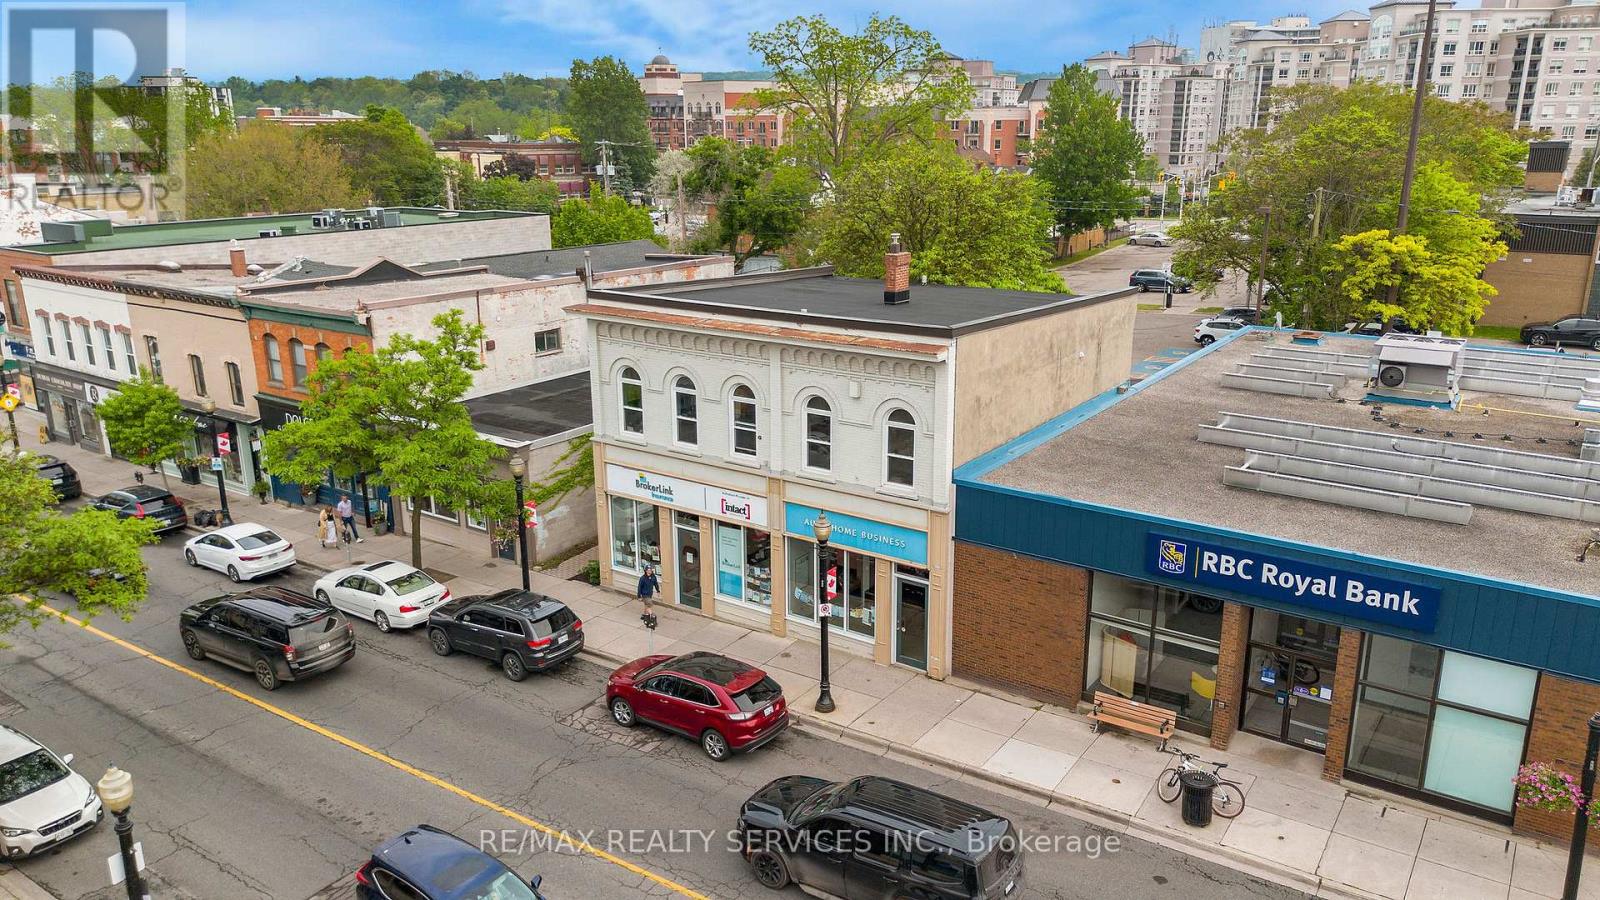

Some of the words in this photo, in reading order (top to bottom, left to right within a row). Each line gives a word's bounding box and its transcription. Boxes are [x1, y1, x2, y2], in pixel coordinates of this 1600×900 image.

[635, 479, 674, 496] BrokerLink
[831, 524, 857, 537] HOME
[861, 530, 906, 548] BUSINESS
[1162, 561, 1182, 572] RBC
[1202, 551, 1254, 581] RBC
[1261, 563, 1337, 599] Royal
[1345, 579, 1420, 616] Bank
